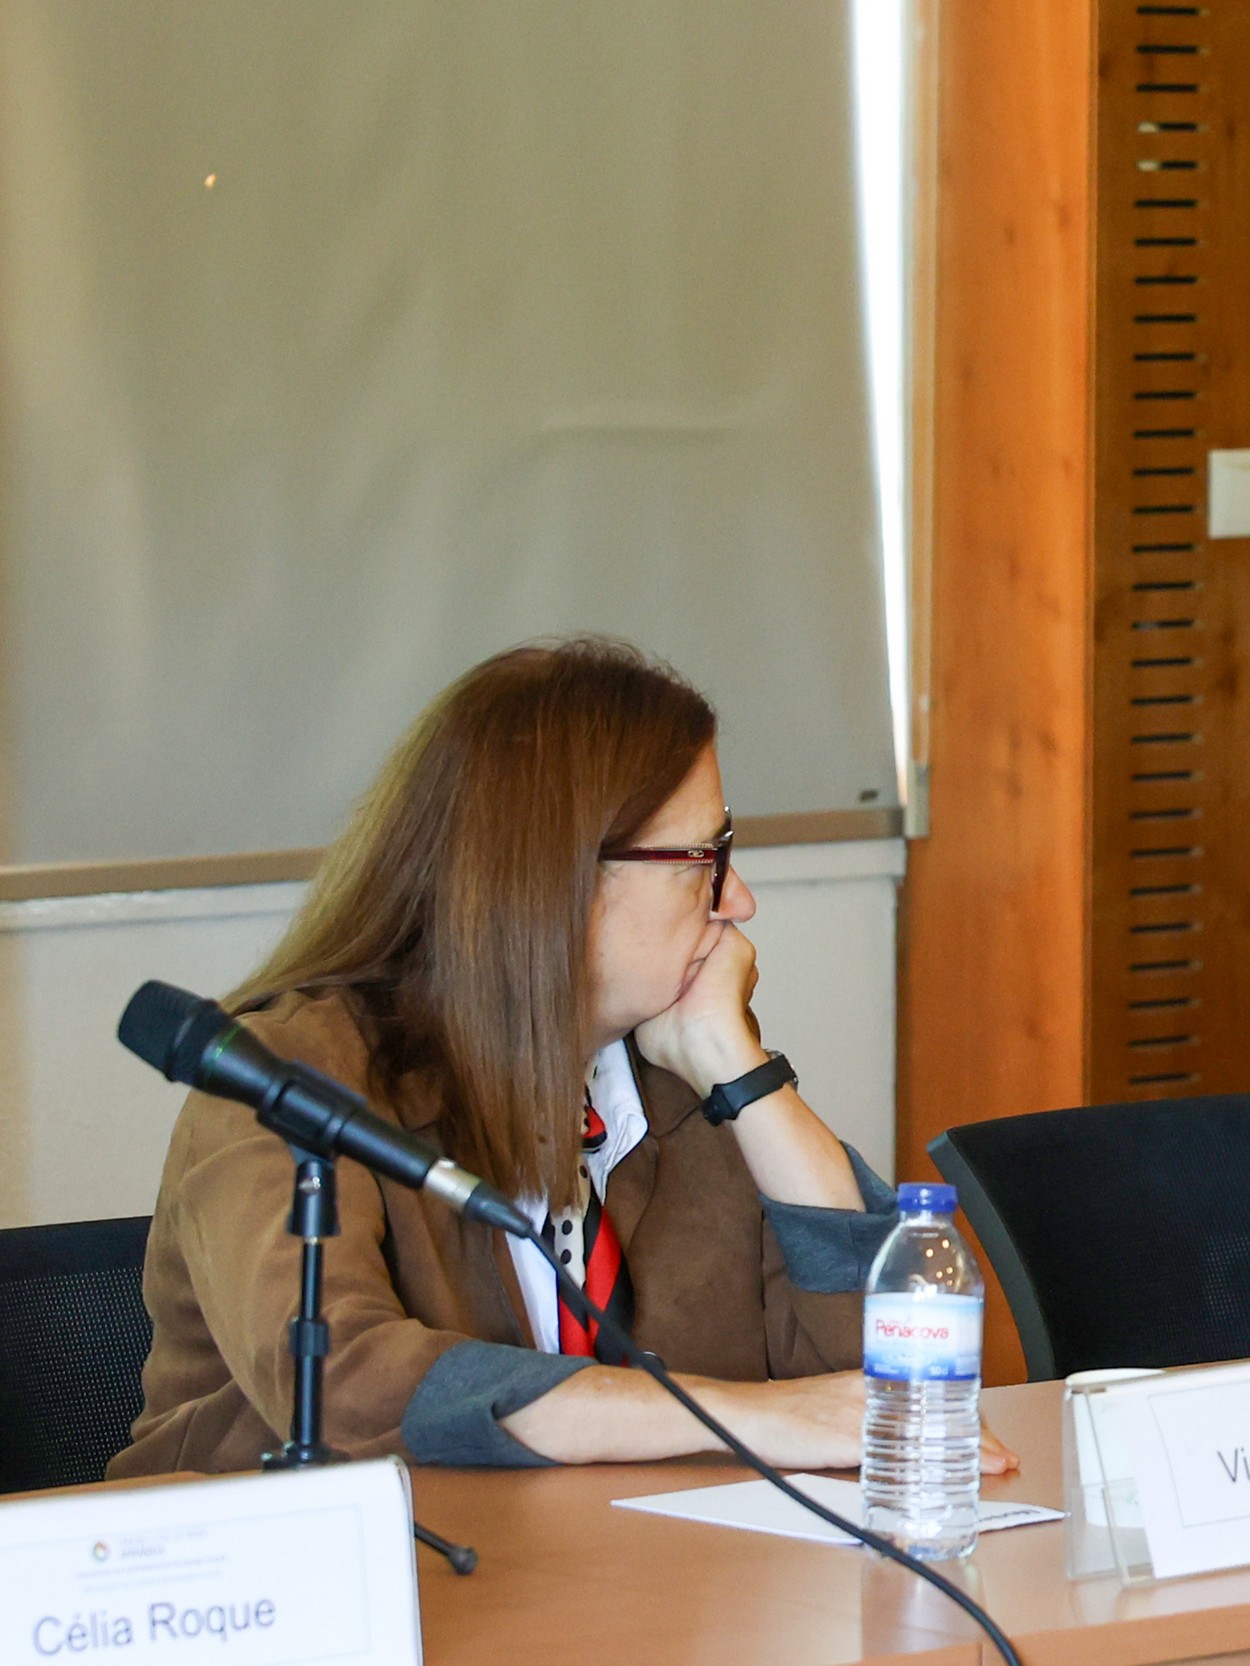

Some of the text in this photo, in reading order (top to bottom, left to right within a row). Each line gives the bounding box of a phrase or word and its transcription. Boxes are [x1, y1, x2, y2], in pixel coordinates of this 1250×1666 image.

[876, 1319, 949, 1340] Penacova
[33, 1598, 276, 1656] Célia Roque
